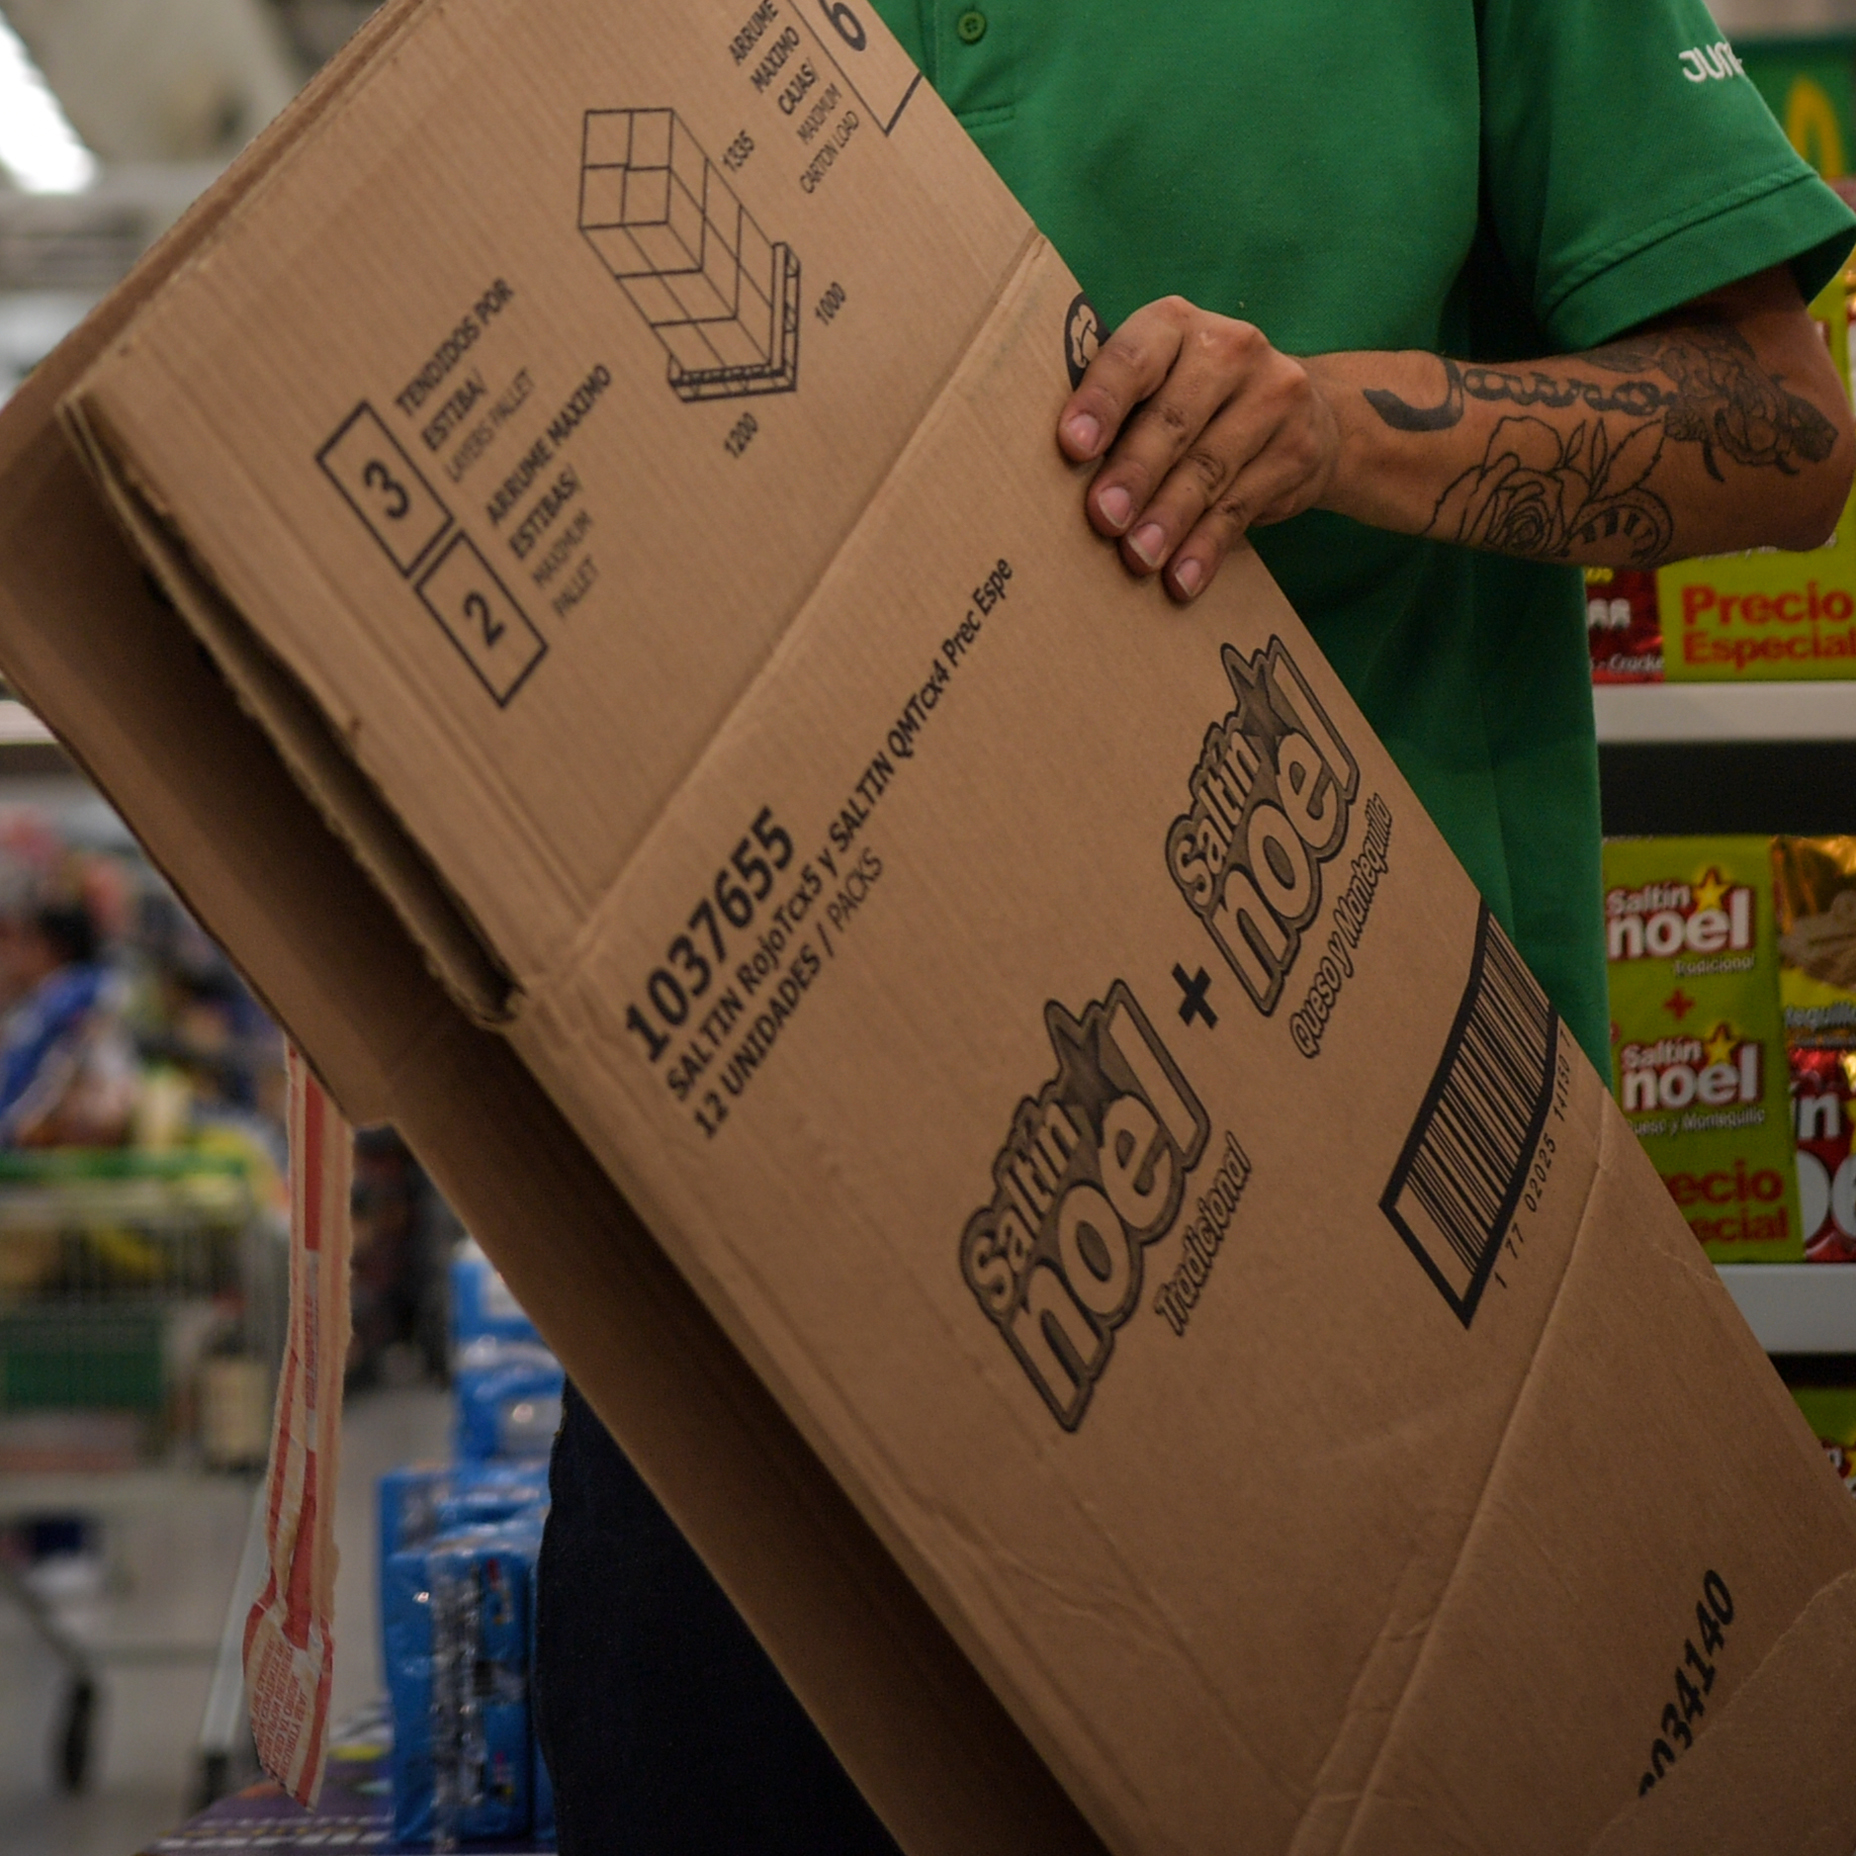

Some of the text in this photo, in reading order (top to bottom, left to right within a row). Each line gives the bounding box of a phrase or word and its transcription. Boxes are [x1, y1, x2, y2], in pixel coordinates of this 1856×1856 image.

[750, 25, 800, 93] MAXIMO
[796, 82, 842, 145] MAXIMUM
[799, 109, 860, 195] CARTON LOAD
[813, 281, 848, 326] 1000
[394, 277, 514, 417] TENDIDOS POR
[445, 366, 535, 485] LAYERS PALLET
[485, 362, 613, 528] ARRUME MAXIMO
[723, 412, 760, 460] 1200
[362, 459, 412, 520] 3
[531, 508, 594, 588] MAXIMUM
[551, 555, 600, 619] PALLET
[462, 590, 507, 646] 2
[1682, 579, 1855, 626] Precio
[665, 556, 1016, 1102] SALTIN RojoTcx5 y SALTIN QMTcx4 Prec Espe
[1172, 726, 1263, 910] Saltín
[1207, 644, 1357, 1011] noel
[625, 806, 796, 1065] 1037655
[1289, 792, 1394, 1059] Queso y Mantequilla
[1606, 878, 1691, 913] Saltín
[1607, 888, 1751, 959] noel
[692, 1088, 730, 1142] 12
[718, 942, 825, 1101] UNIDADES
[824, 846, 886, 935] PACKS
[1674, 955, 1756, 976] Tradicional
[1621, 1033, 1702, 1068] Saltín
[1623, 1045, 1761, 1111] noel
[1504, 1223, 1525, 1260] 77
[1522, 1132, 1557, 1213] 02025
[1552, 1053, 1573, 1123] 14150
[1683, 1105, 1766, 1131] Mantequilla
[968, 1095, 1084, 1316] Saltín
[1007, 989, 1206, 1429] noel
[1154, 1130, 1254, 1339] Tradicional
